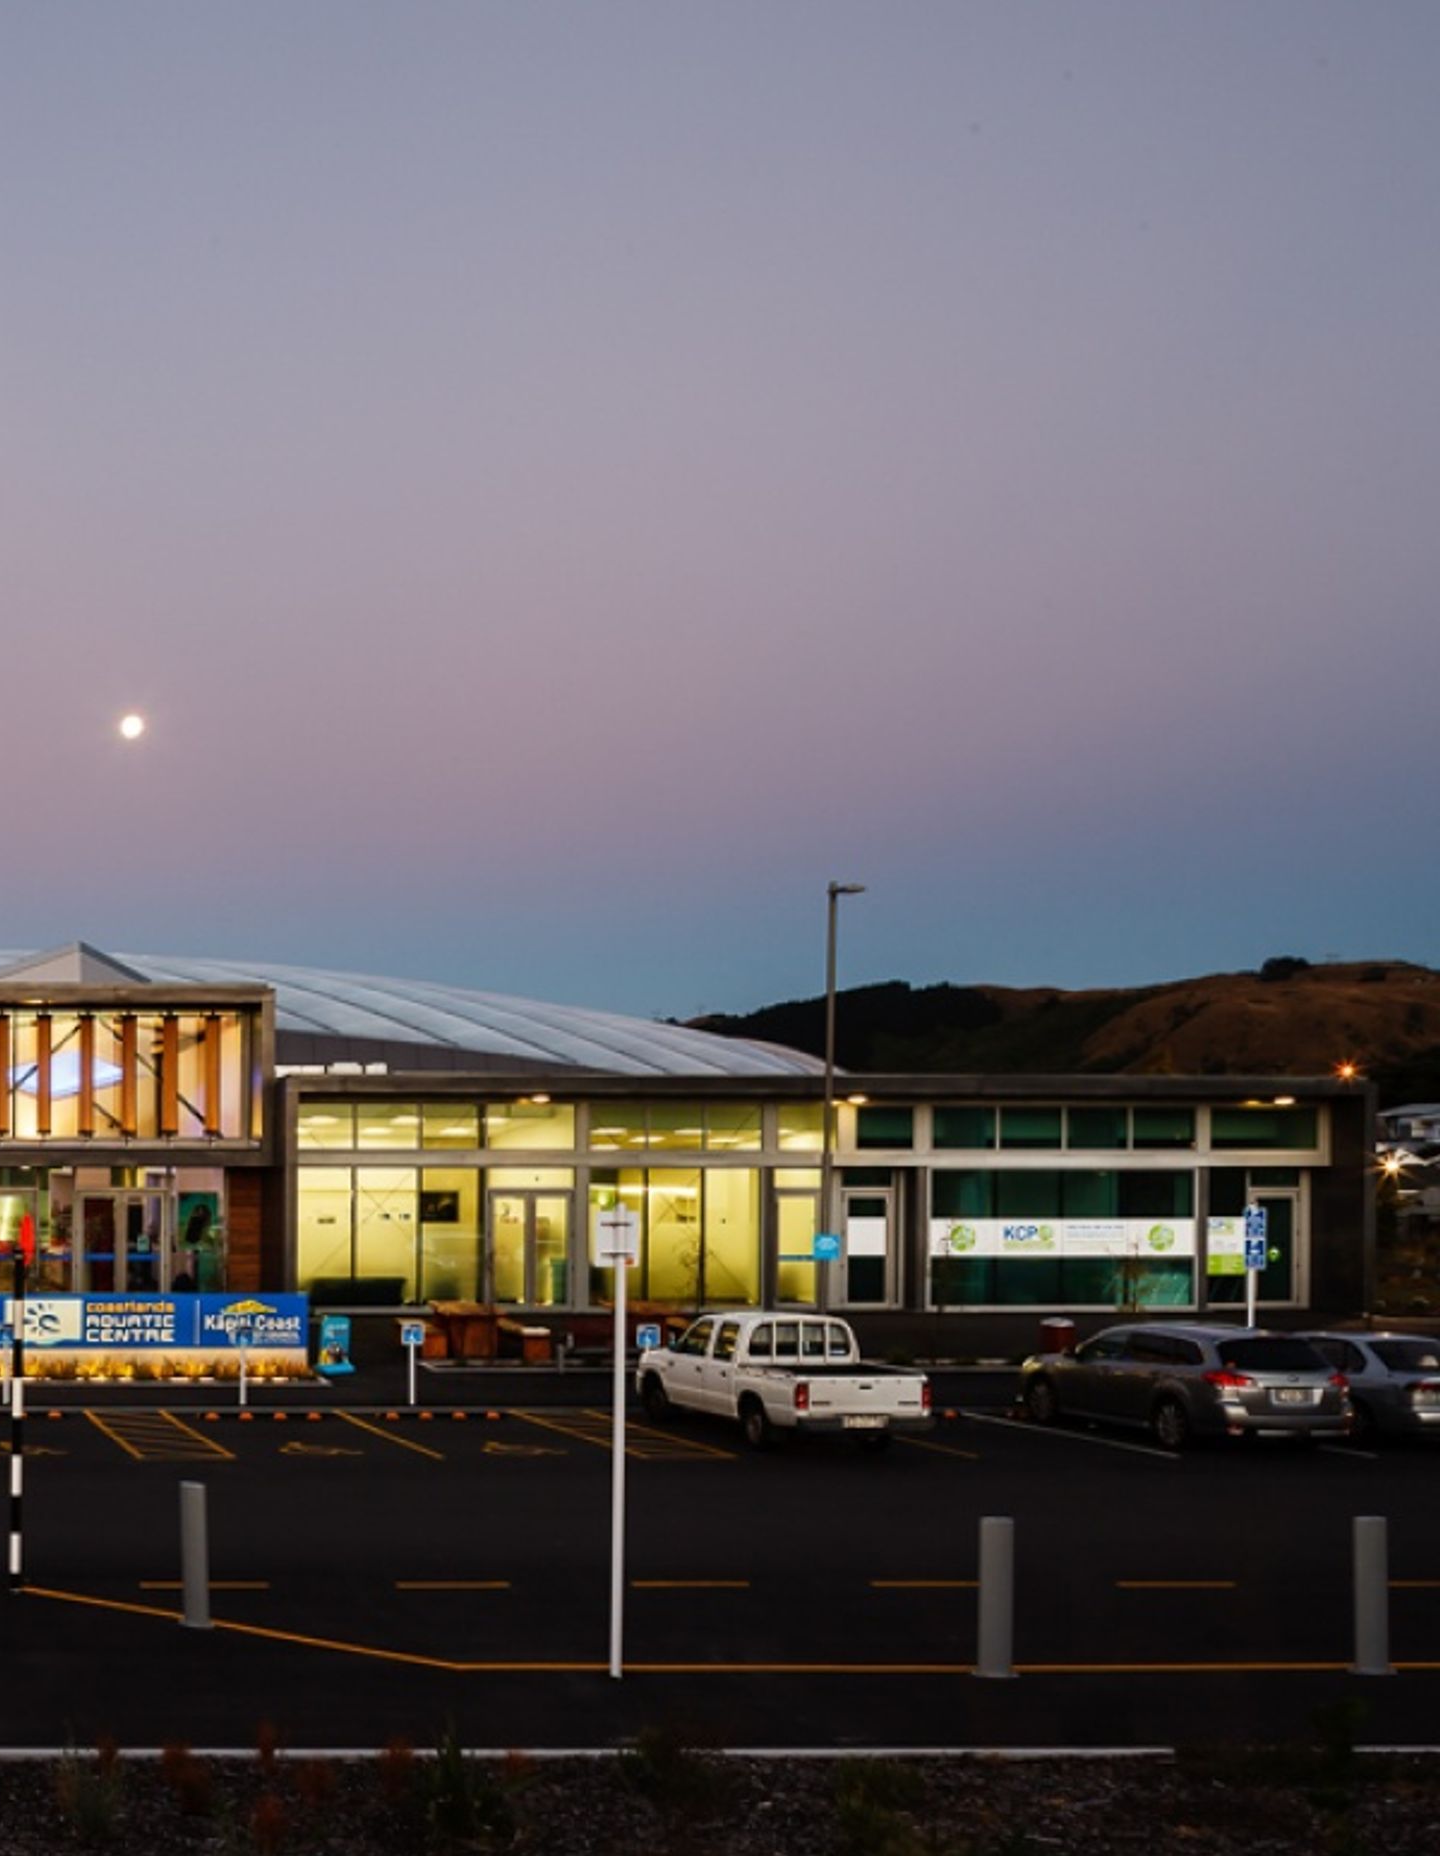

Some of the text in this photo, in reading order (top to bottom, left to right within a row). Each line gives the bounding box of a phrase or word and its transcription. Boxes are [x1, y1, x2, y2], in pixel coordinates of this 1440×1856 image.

[86, 1301, 175, 1313] coastlands
[86, 1314, 175, 1328] AQUATIC
[254, 1314, 301, 1330] Coast
[86, 1328, 175, 1342] CENTRE
